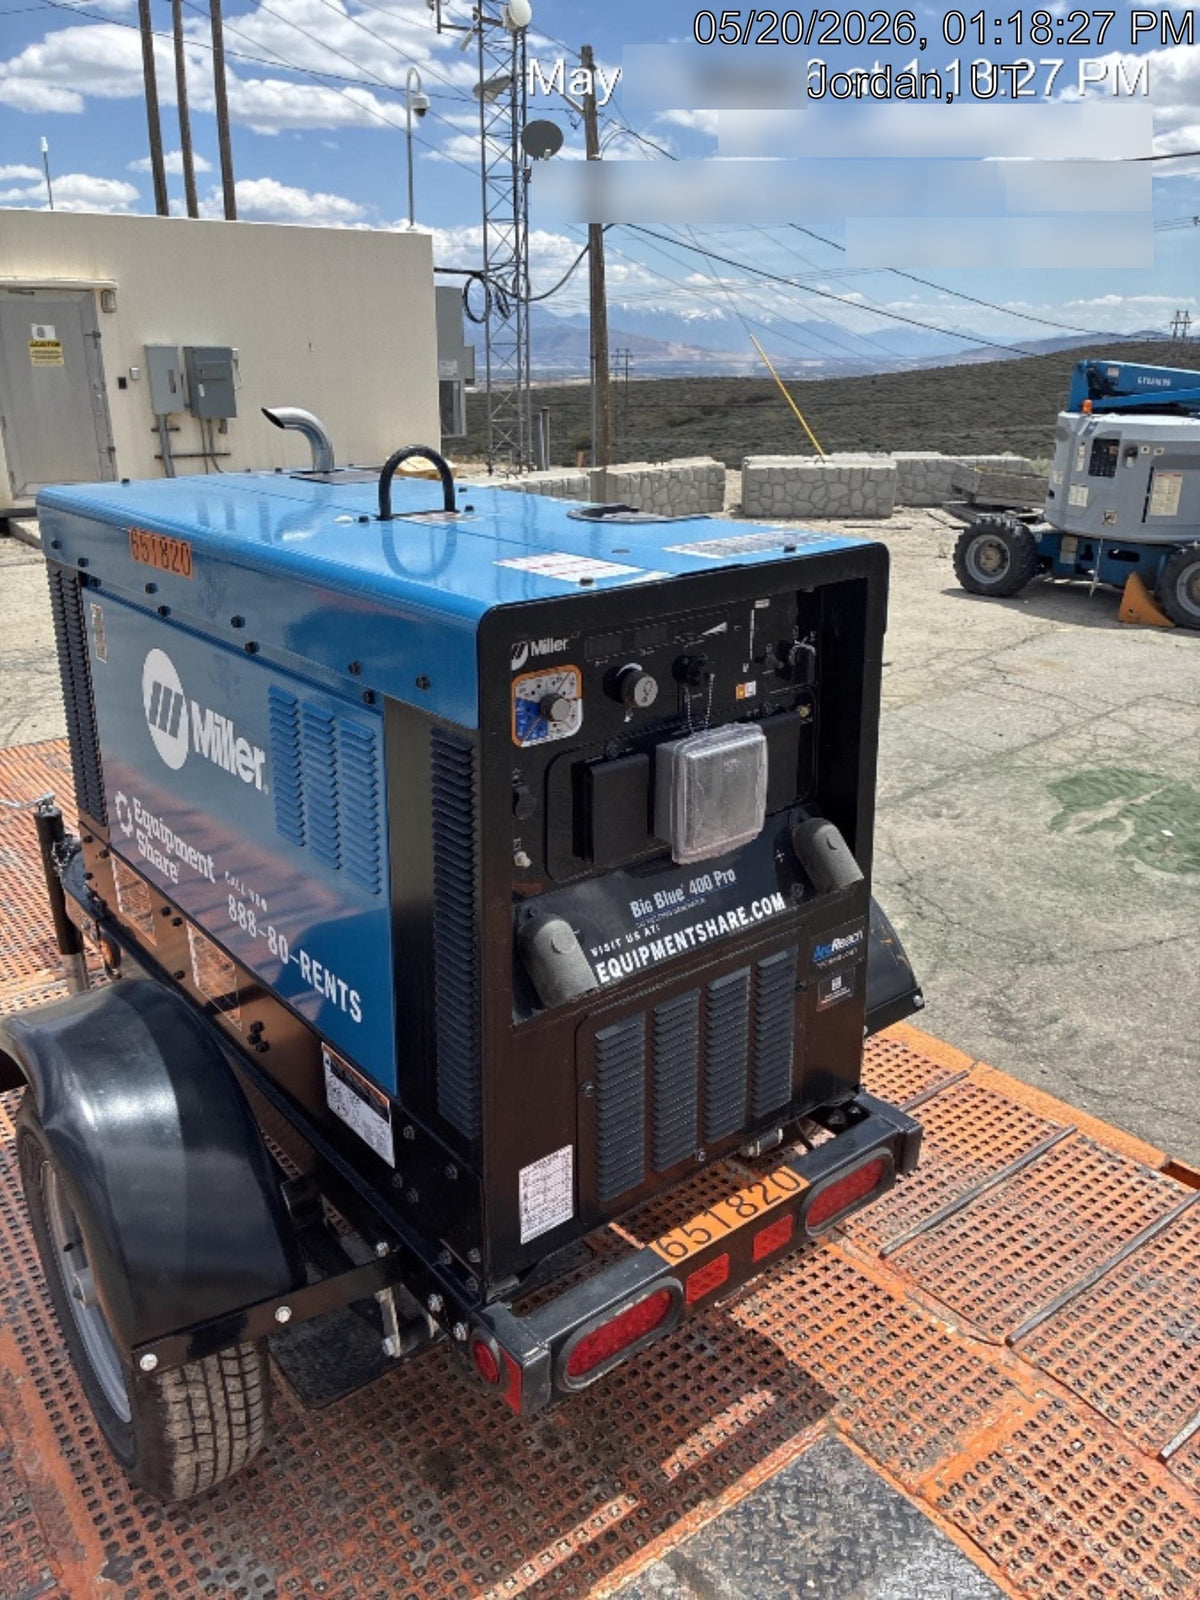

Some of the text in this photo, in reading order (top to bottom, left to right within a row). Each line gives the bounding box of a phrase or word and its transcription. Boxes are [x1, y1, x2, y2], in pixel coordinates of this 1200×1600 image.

[130, 528, 191, 577] 651820
[530, 637, 569, 657] Miller
[190, 699, 266, 791] Miller
[132, 797, 216, 883] Equipment
[135, 827, 179, 884] Share
[629, 898, 653, 919] Big
[653, 888, 686, 910] Blue
[689, 874, 714, 896] 400
[713, 868, 738, 887] Pro
[227, 893, 363, 1024] 888-80-RENTS
[590, 937, 622, 957] VISIT
[626, 930, 641, 943] US
[595, 891, 787, 985] EQUIPMENTSHARE.COM
[655, 1169, 802, 1259] 651820
